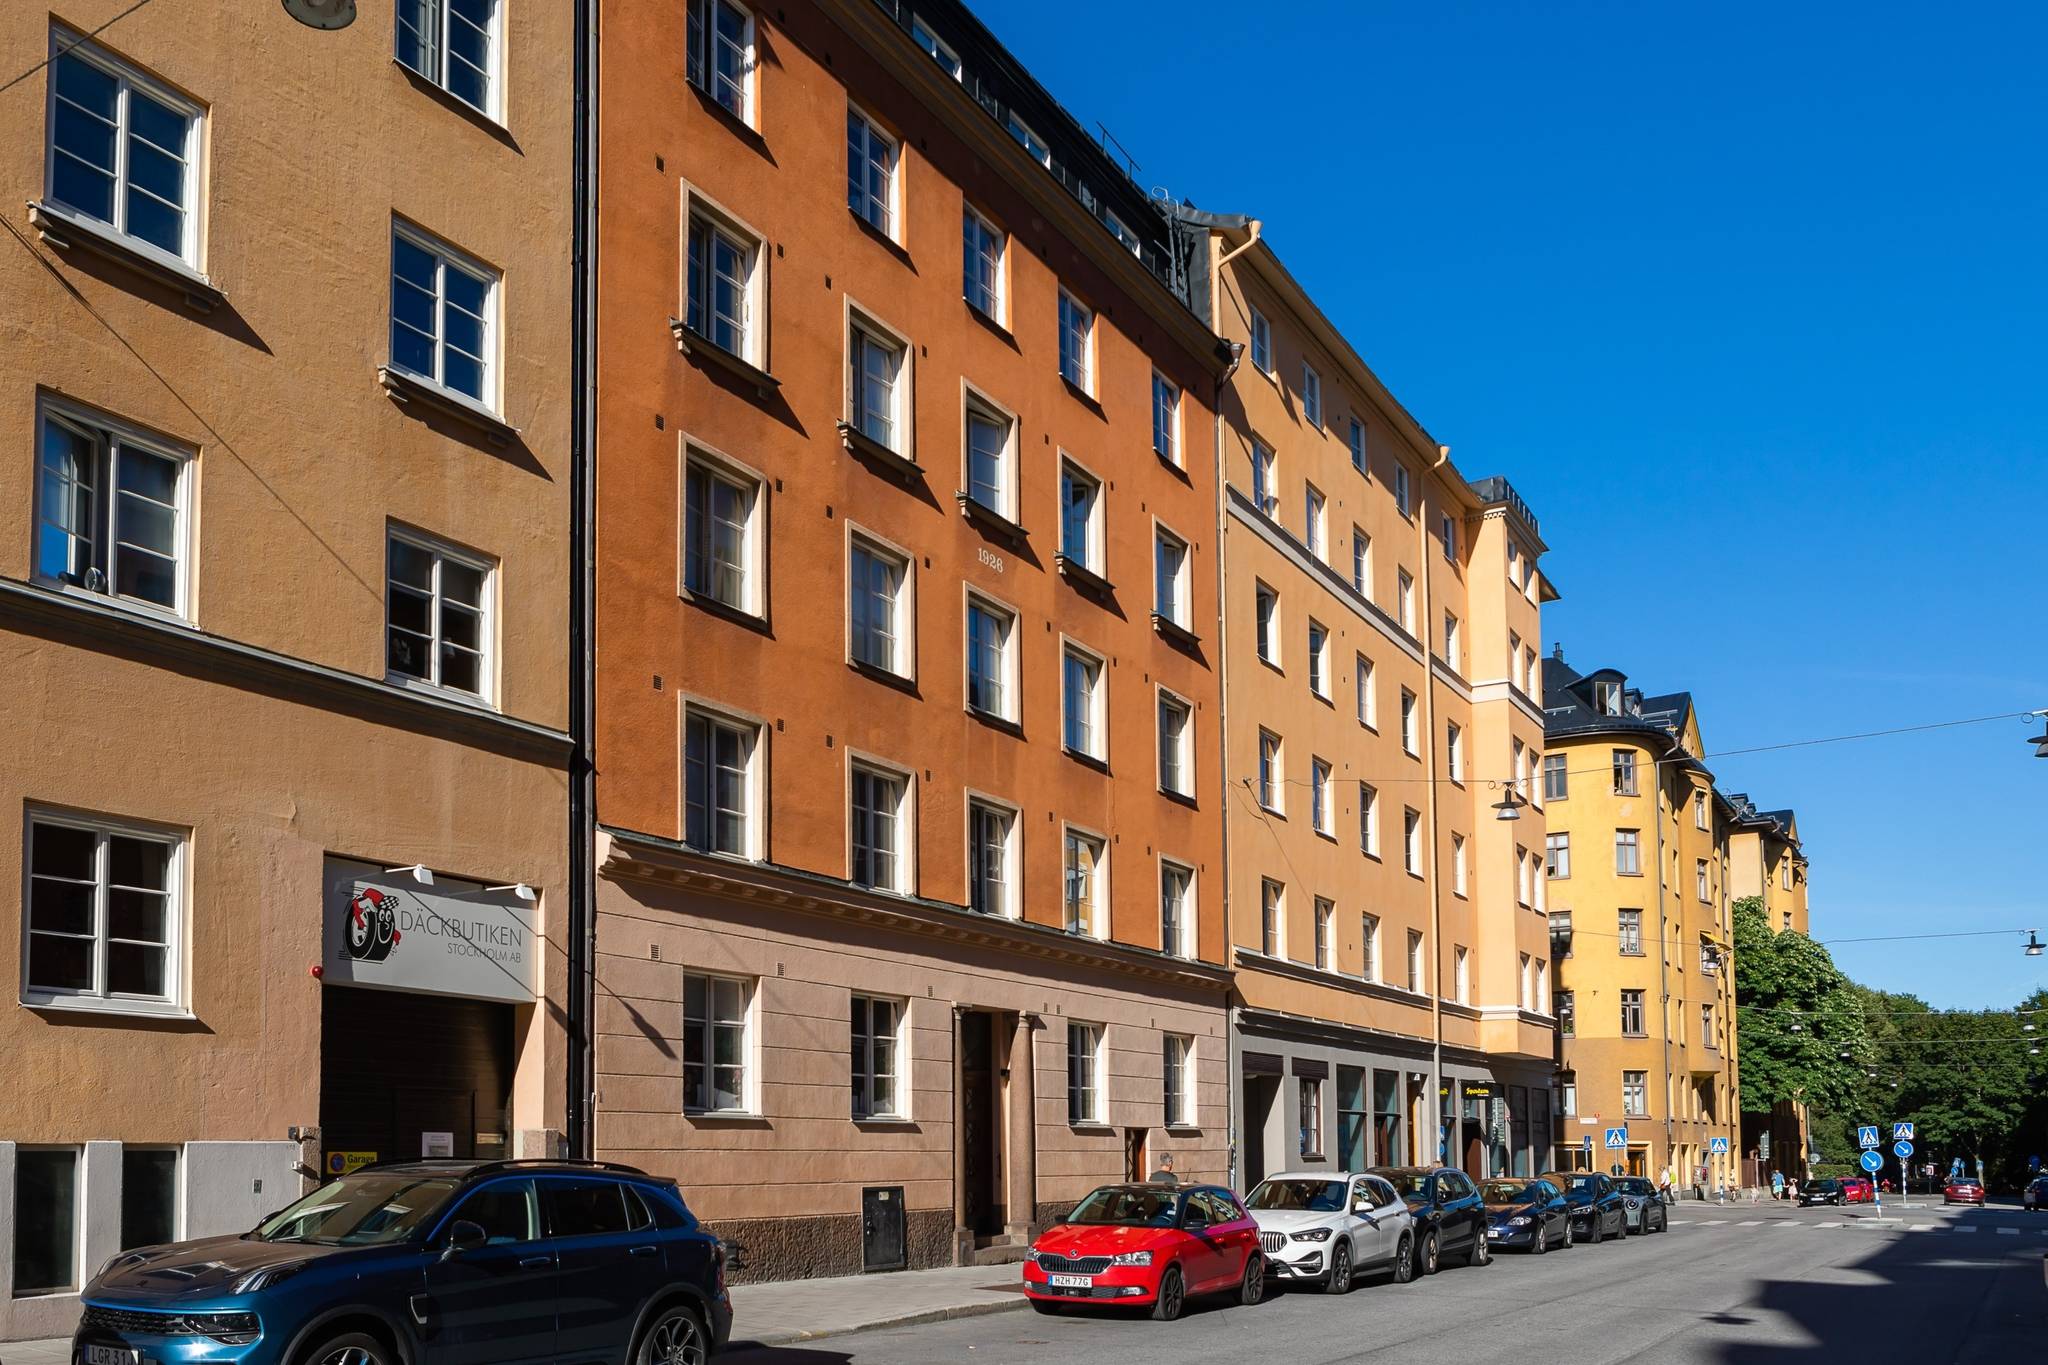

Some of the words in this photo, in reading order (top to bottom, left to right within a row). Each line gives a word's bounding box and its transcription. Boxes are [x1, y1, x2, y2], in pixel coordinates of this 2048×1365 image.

[977, 547, 1004, 573] 1926
[400, 908, 522, 947] DÄCKBUTIKEN
[447, 943, 508, 962] STOCKHOLM
[510, 952, 521, 964] AB
[1055, 1276, 1071, 1285] HZH
[1072, 1277, 1089, 1286] 77G
[92, 1347, 110, 1364] LGR
